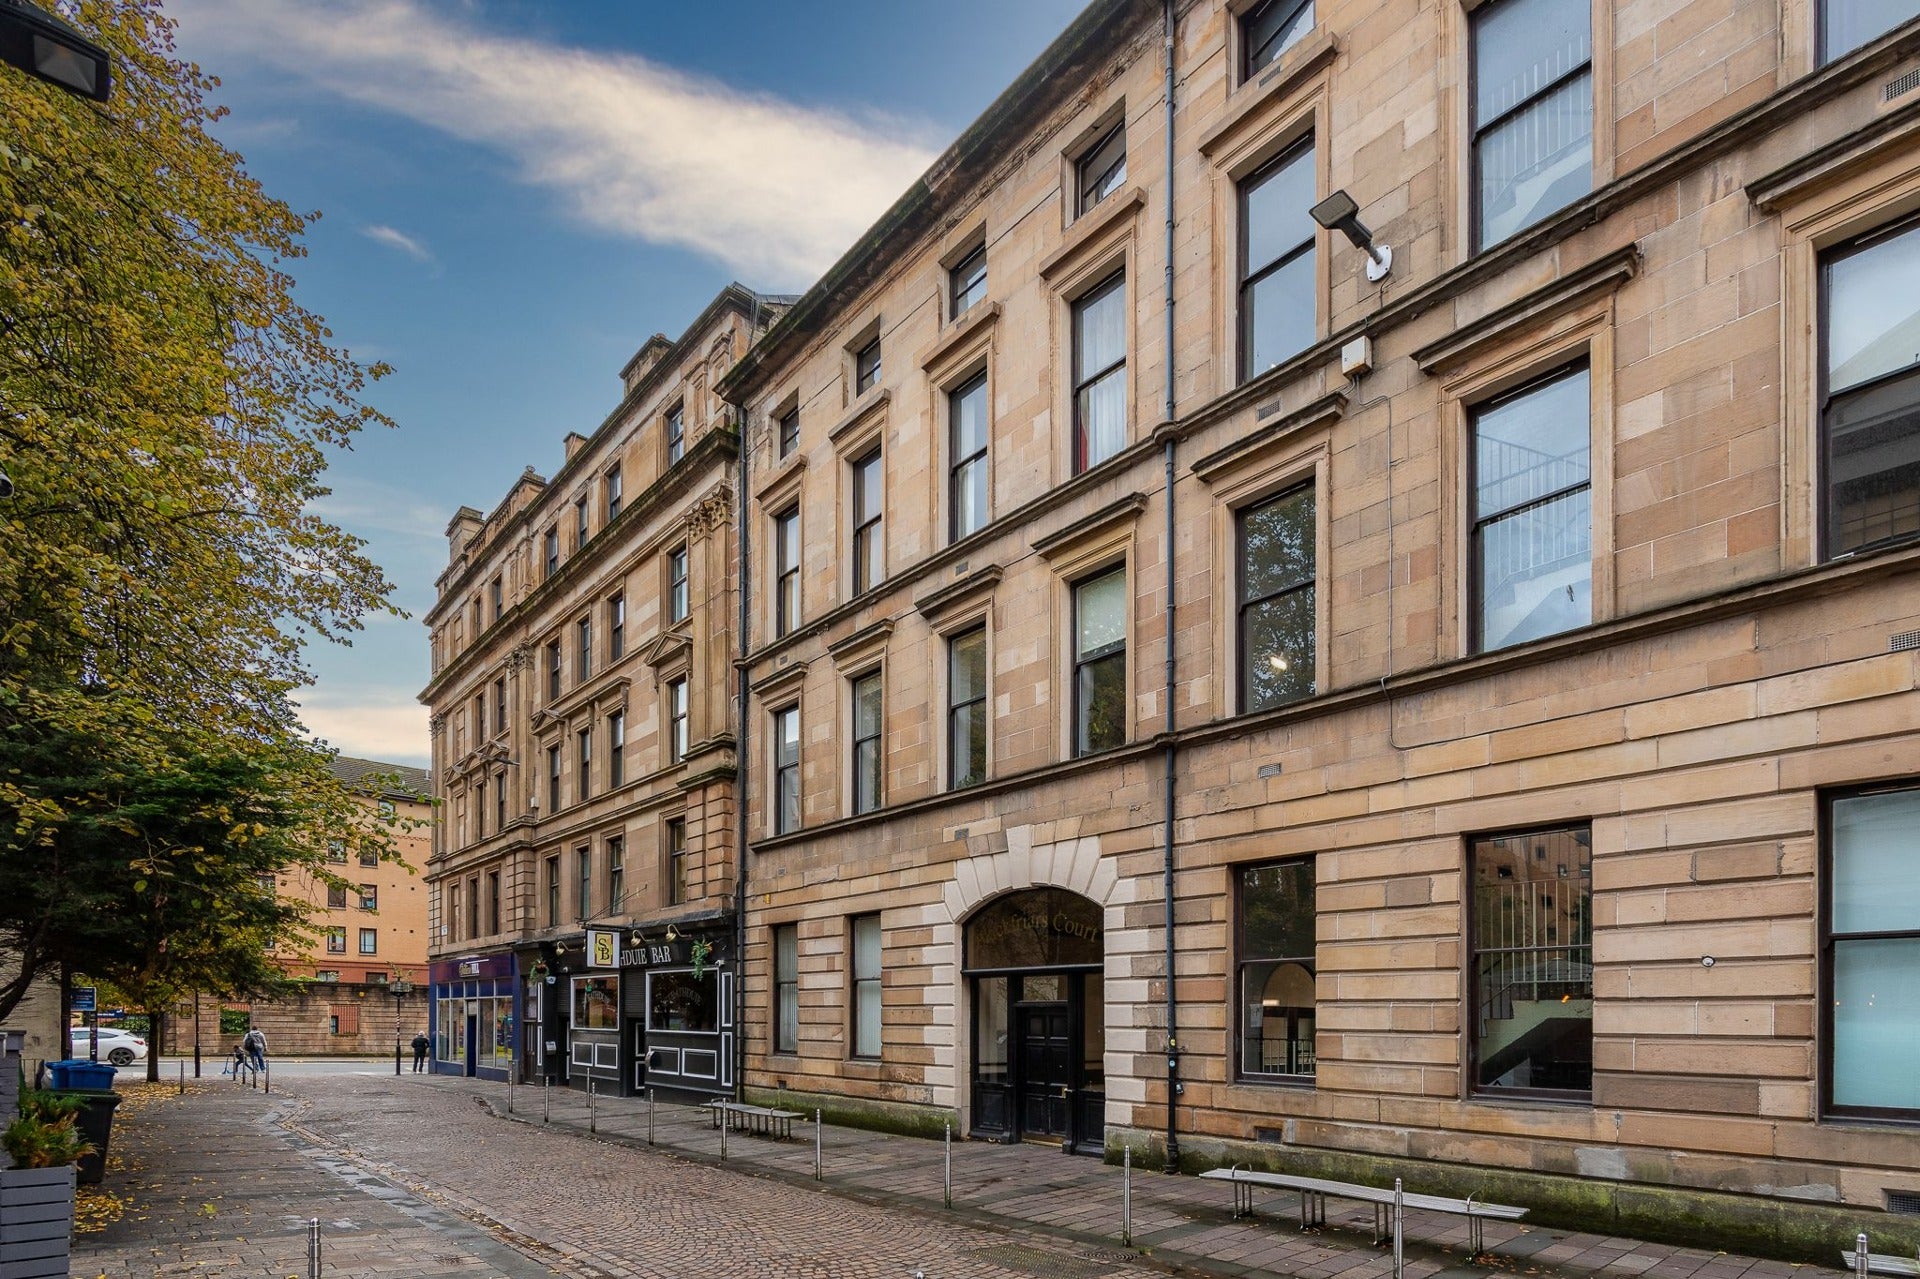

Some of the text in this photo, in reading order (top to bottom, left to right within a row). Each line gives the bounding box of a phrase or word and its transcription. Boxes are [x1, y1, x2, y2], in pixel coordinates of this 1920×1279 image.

[977, 910, 1098, 944] ckfriars Court
[620, 945, 672, 967] HDUIE BAR
